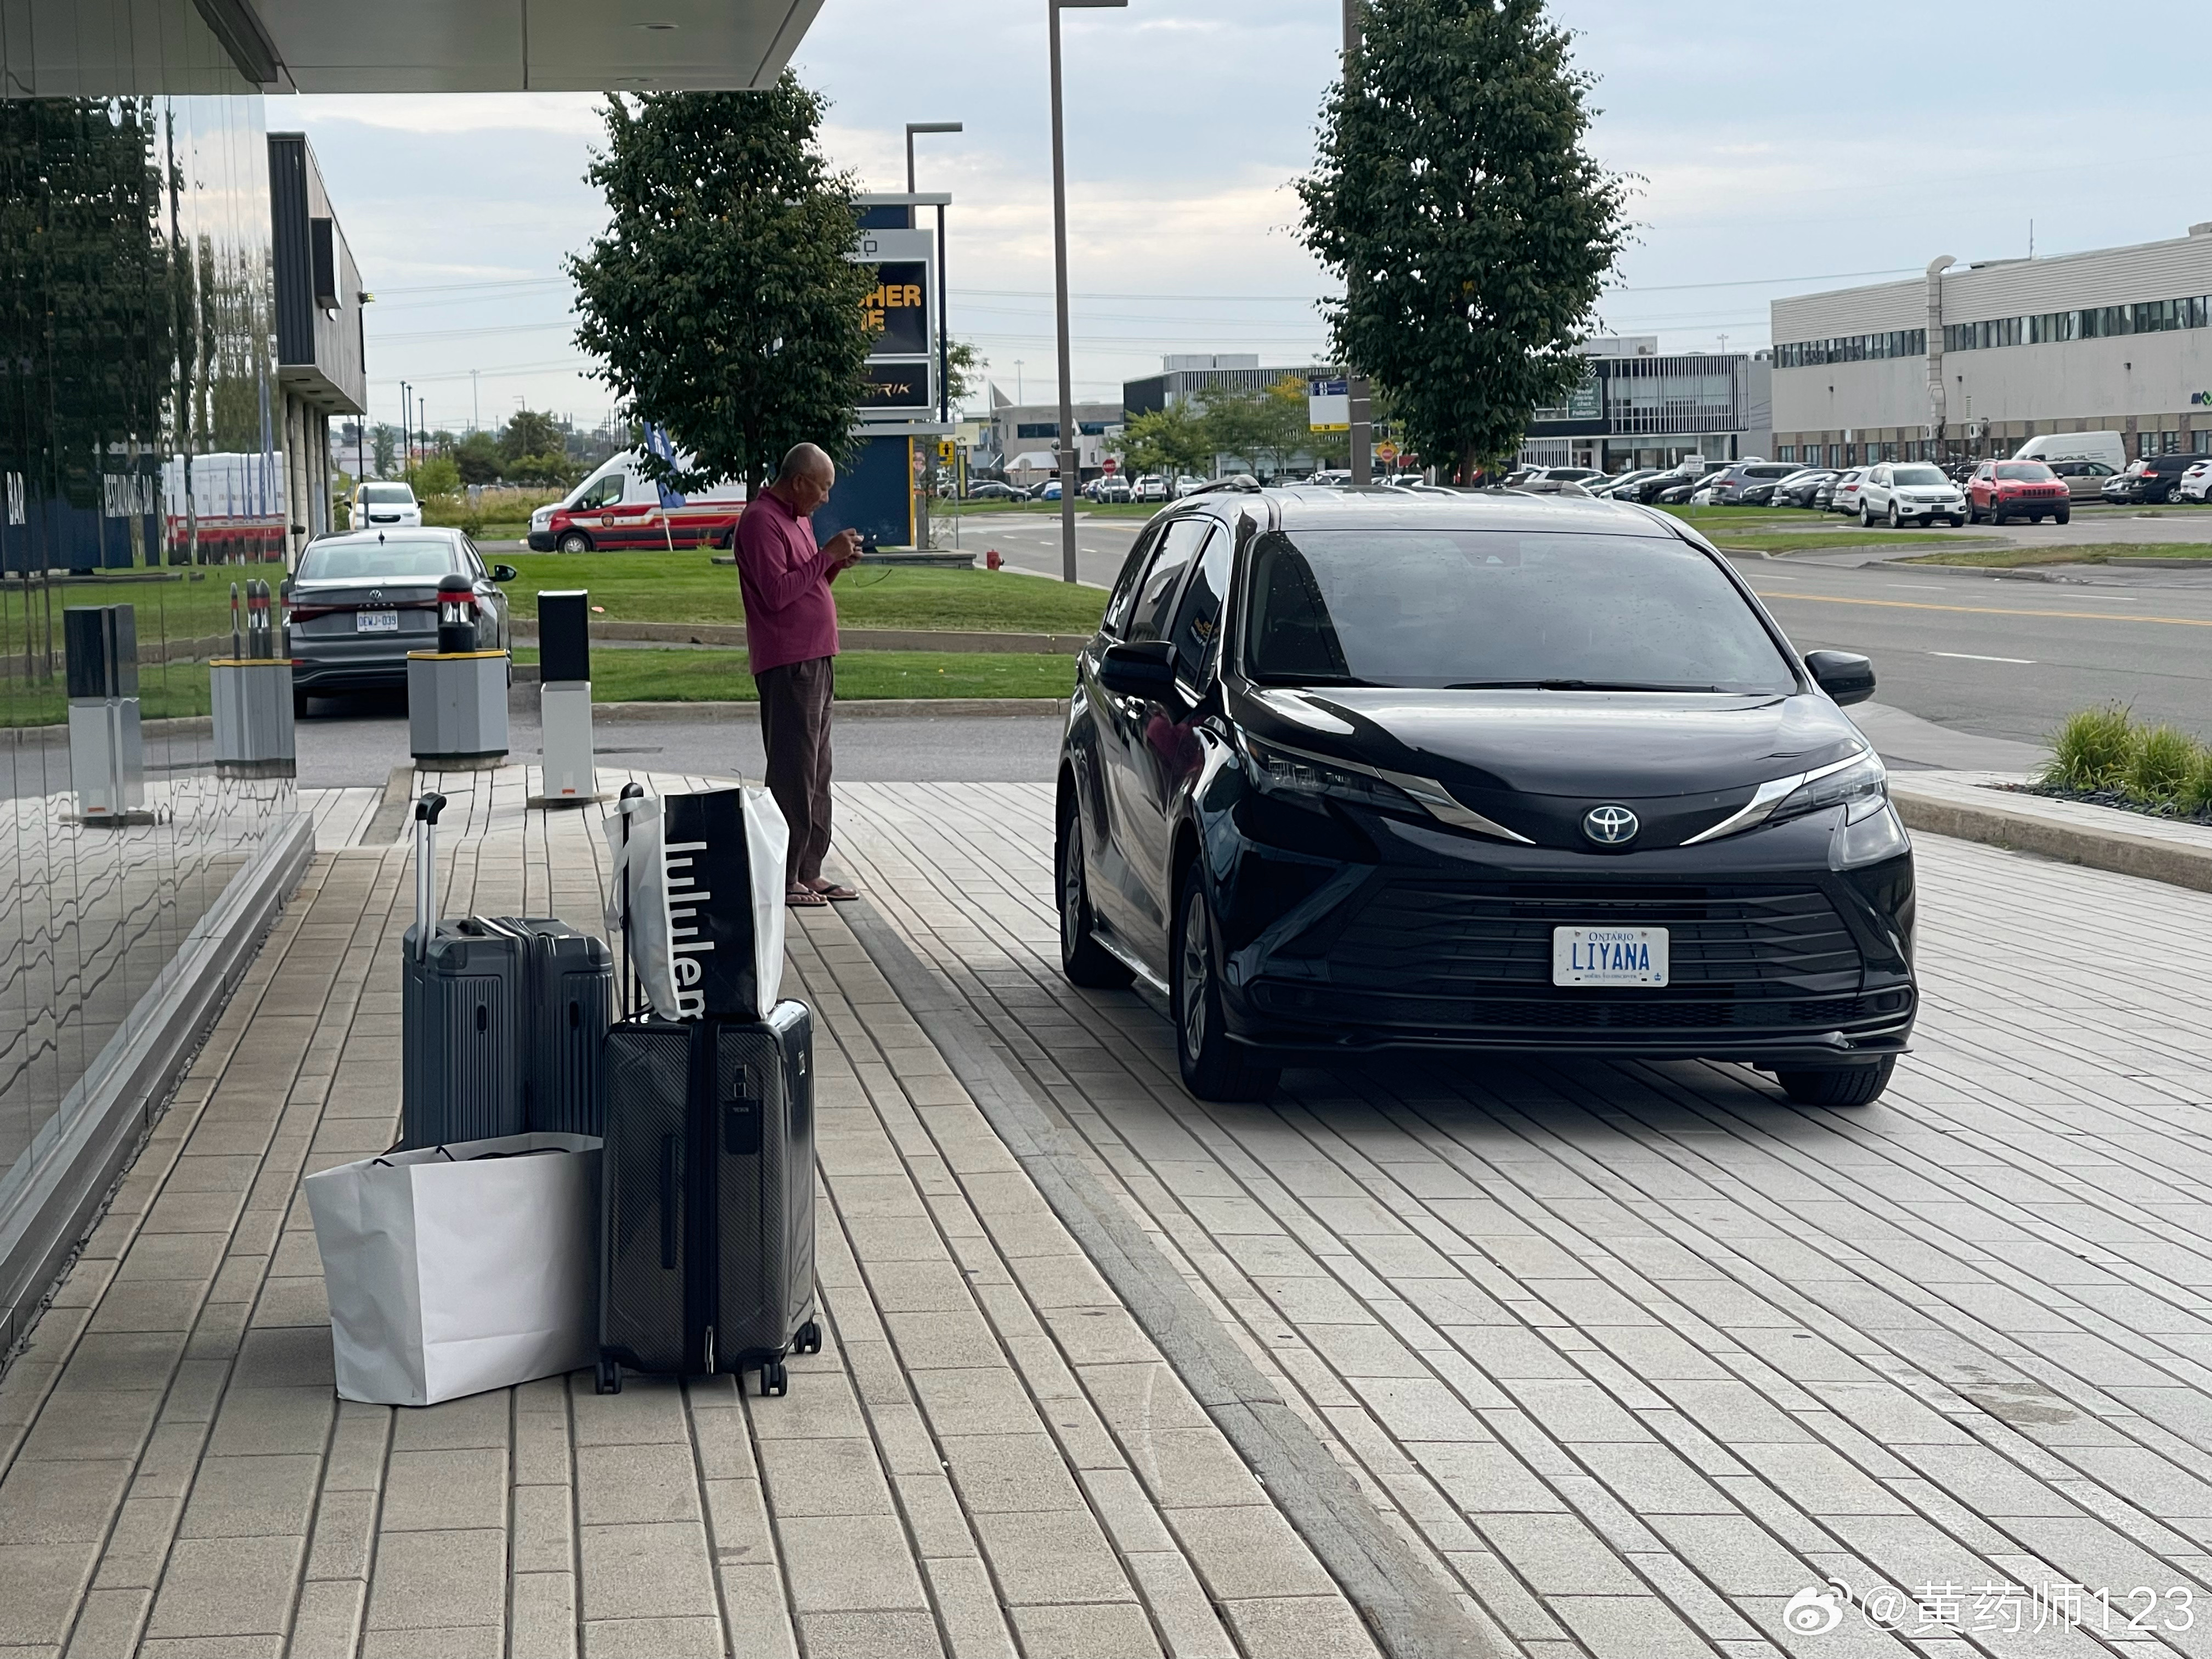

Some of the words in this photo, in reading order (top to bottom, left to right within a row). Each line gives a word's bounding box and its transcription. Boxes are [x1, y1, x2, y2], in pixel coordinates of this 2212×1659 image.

[857, 285, 922, 307] HER
[877, 382, 913, 398] RIK
[1589, 932, 1634, 941] ONTARIO
[1572, 943, 1650, 970] LIYANA
